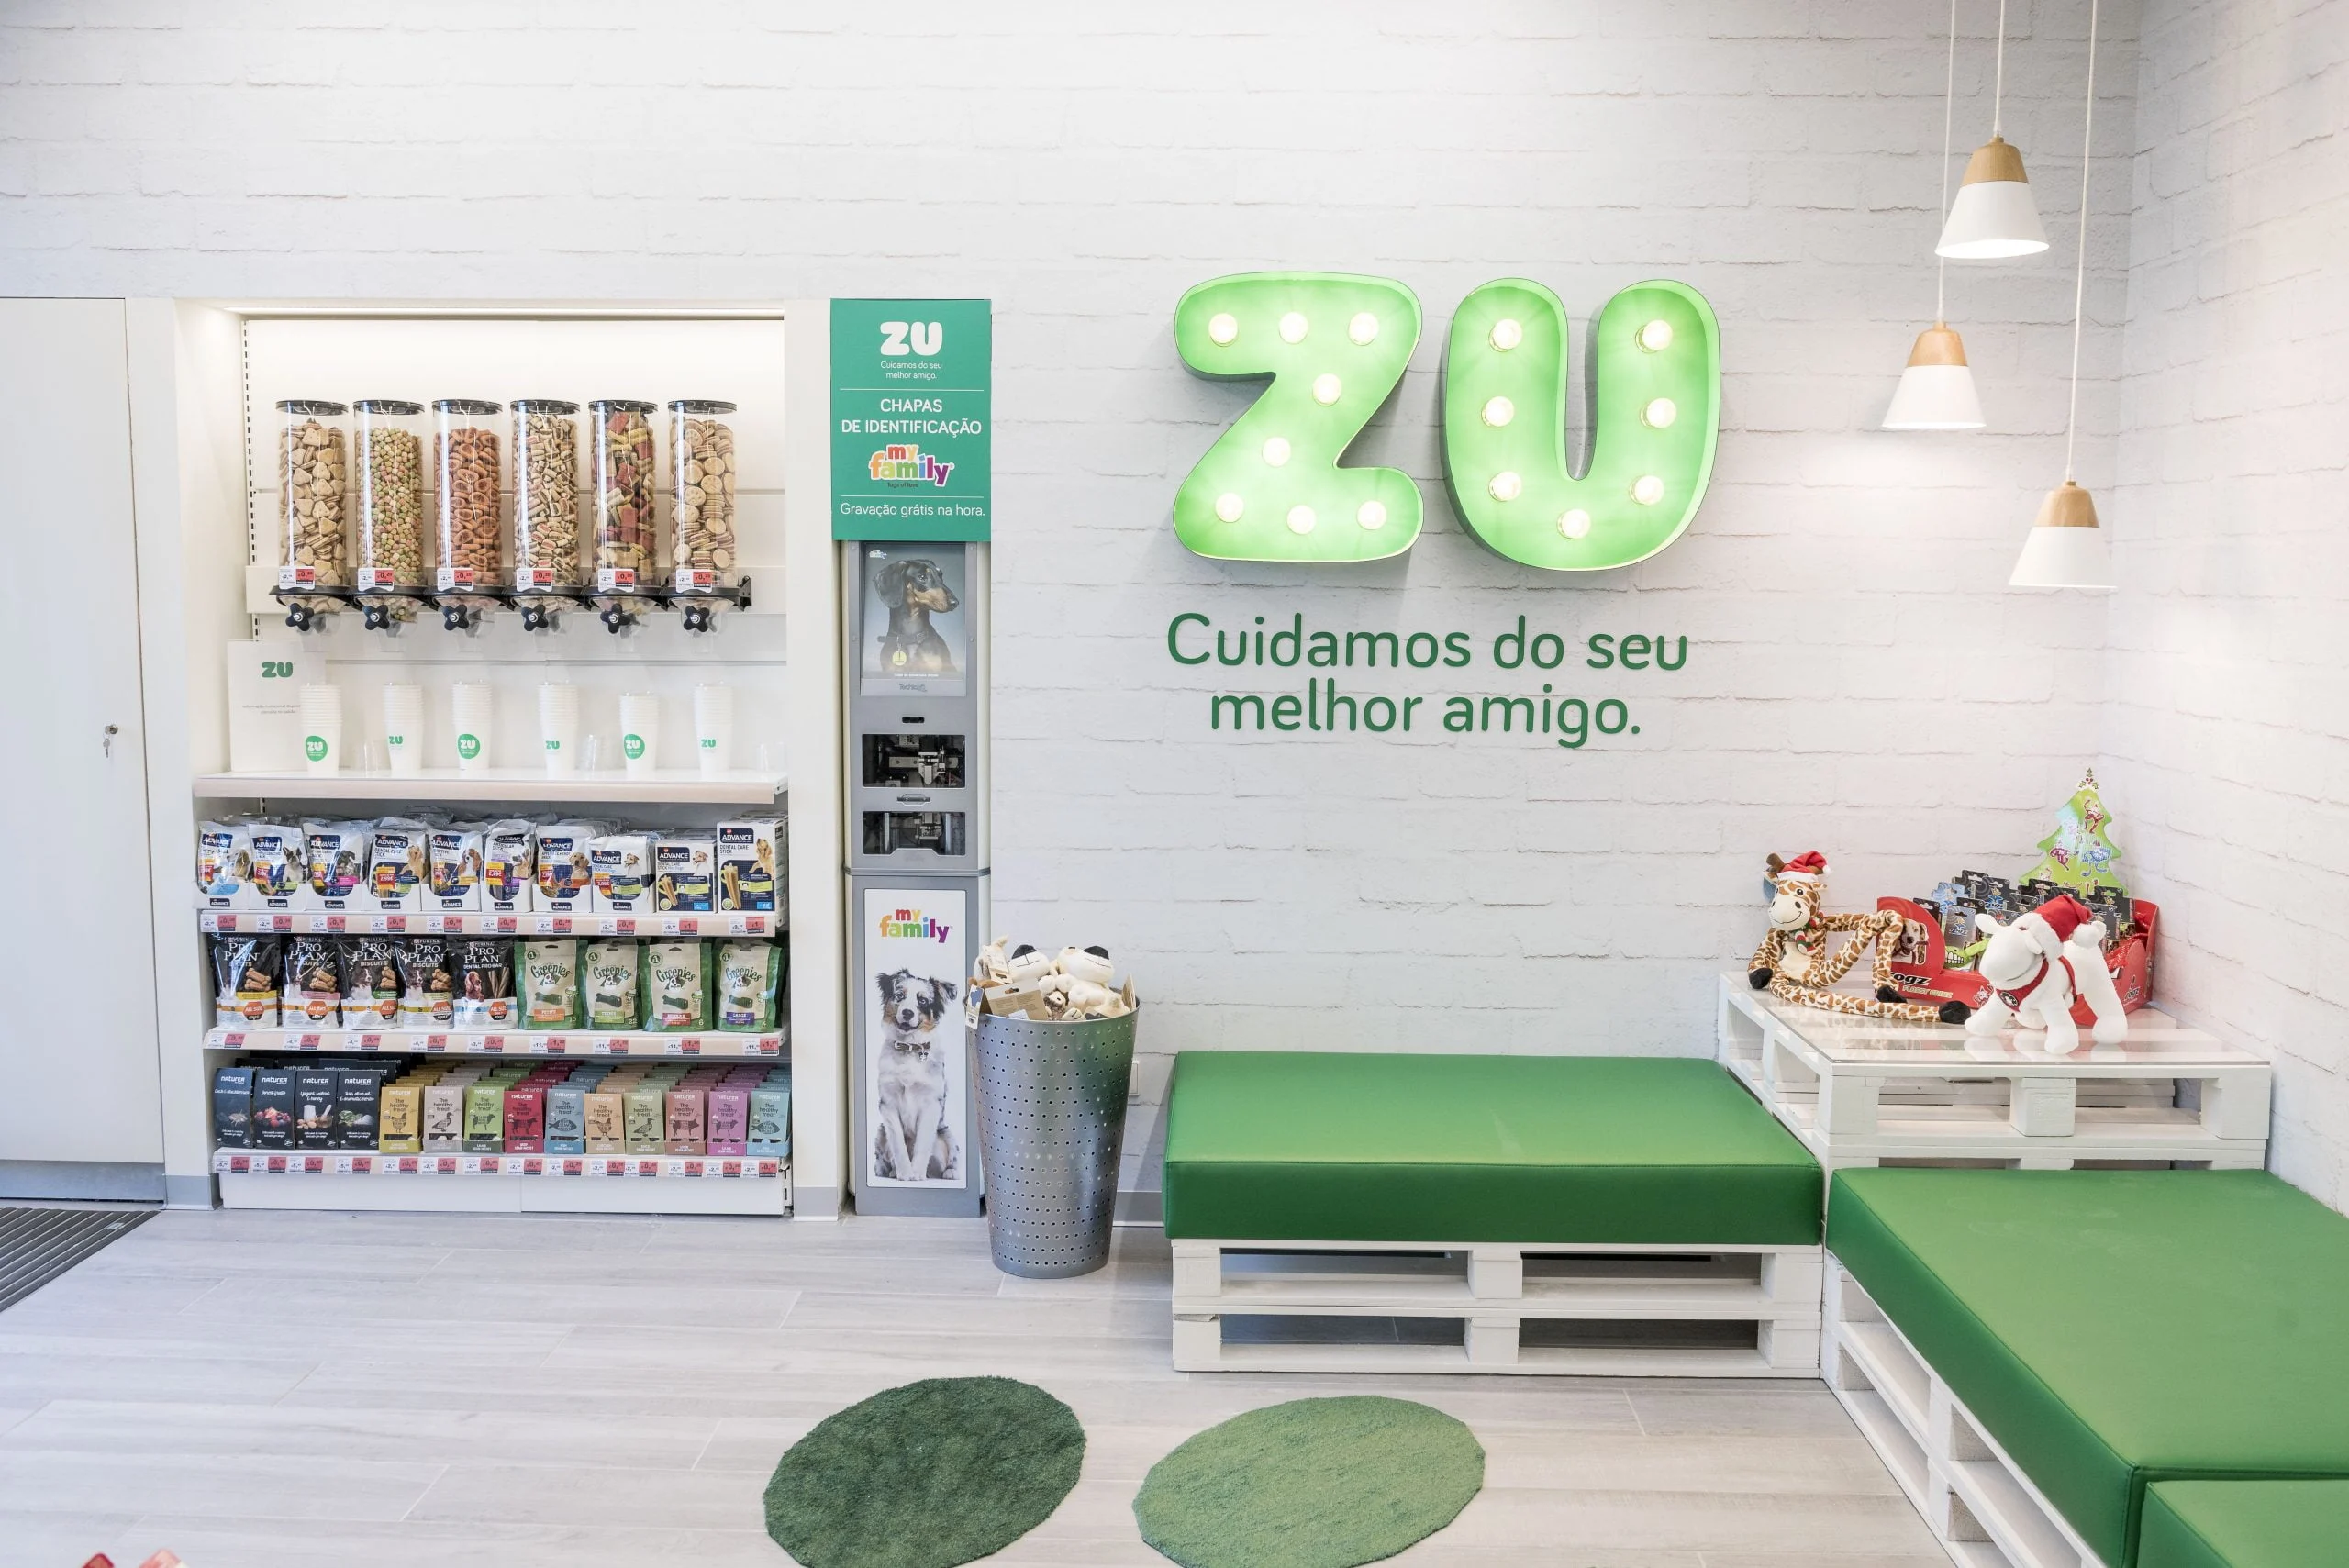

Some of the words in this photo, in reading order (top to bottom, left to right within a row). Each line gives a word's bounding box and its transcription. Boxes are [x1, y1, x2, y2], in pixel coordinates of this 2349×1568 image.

[880, 321, 943, 356] ZU
[880, 361, 917, 369] Cuidamos
[918, 361, 929, 369] do
[885, 371, 912, 379] melhor
[913, 372, 937, 381] amigo.
[880, 398, 942, 413] CHAPAS
[841, 419, 861, 433] DE
[865, 417, 982, 438] IDENTIFICAÇÃO
[1173, 272, 1721, 572] ZU
[887, 444, 918, 460] my
[869, 452, 949, 486] family
[840, 502, 897, 517] Gravação
[901, 503, 934, 517] grátis
[938, 506, 952, 516] na
[956, 504, 985, 517] hora.
[1167, 612, 1471, 669] Cuidamos
[1493, 615, 1564, 670] do
[1586, 631, 1688, 671] seu
[262, 662, 294, 678] ZU
[1210, 677, 1423, 733] melhor
[1443, 684, 1642, 749] amigo.
[306, 741, 324, 751] ZU
[389, 735, 403, 745] ZU
[460, 740, 476, 750] ZU
[545, 740, 560, 750] ZU
[625, 740, 640, 750] ZU
[701, 739, 716, 748] ZU
[895, 907, 921, 922] my
[879, 915, 950, 943] family
[296, 942, 322, 952] PRO
[361, 942, 387, 952] PRO
[415, 944, 440, 953] PRO
[408, 953, 446, 962] PLAN
[464, 955, 501, 963] PLAN
[530, 962, 571, 978] Greenies
[593, 964, 632, 980] Greenies
[656, 966, 696, 983] Greenies
[725, 966, 763, 982] Greenies
[1890, 973, 1932, 985] ogz
